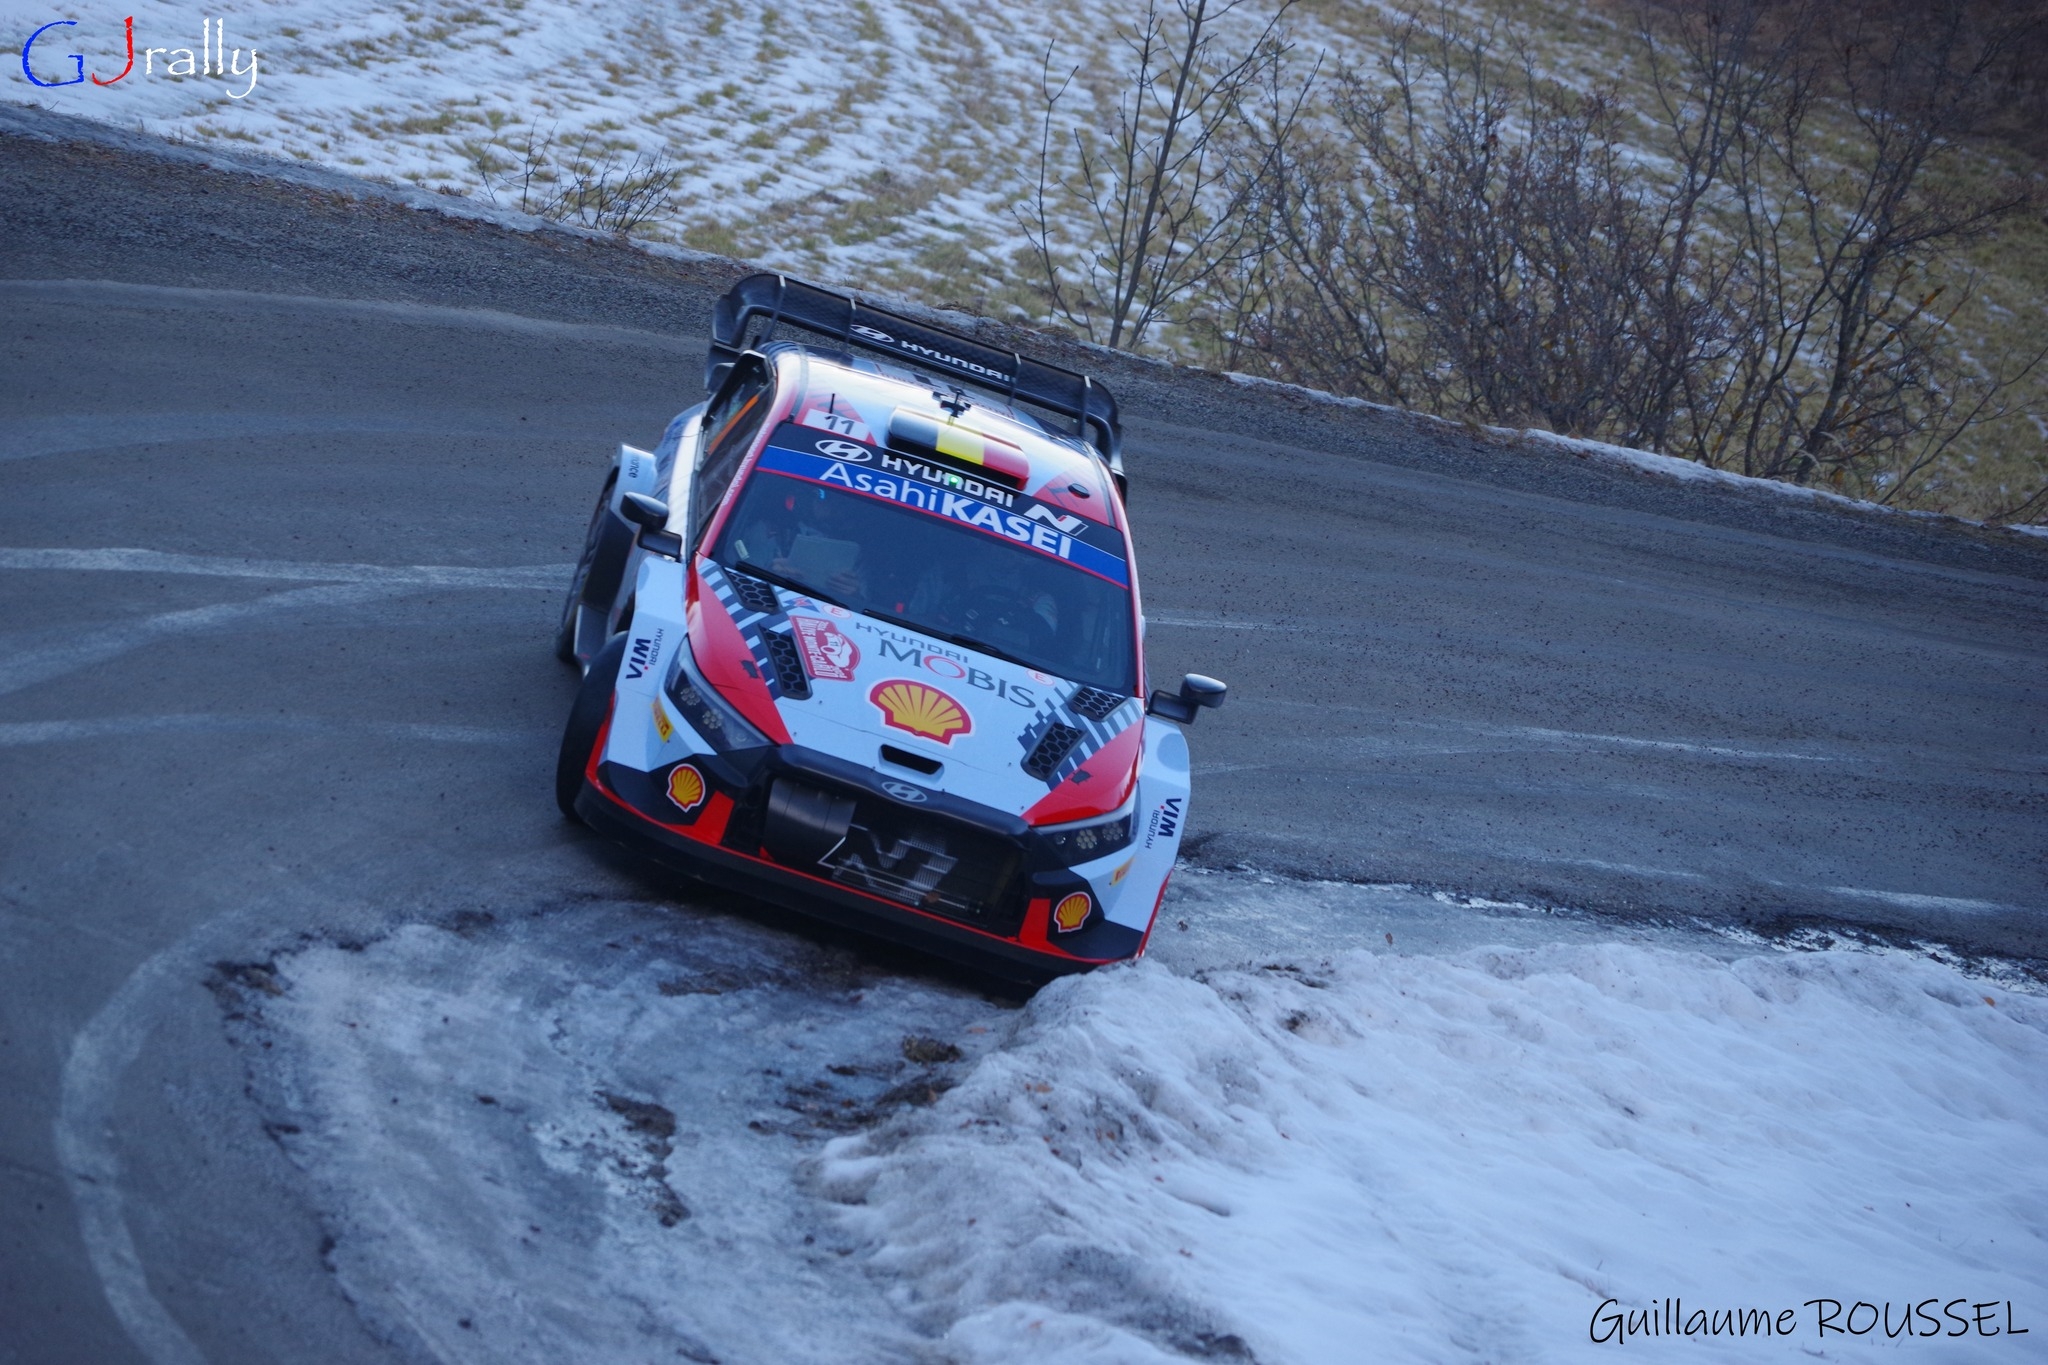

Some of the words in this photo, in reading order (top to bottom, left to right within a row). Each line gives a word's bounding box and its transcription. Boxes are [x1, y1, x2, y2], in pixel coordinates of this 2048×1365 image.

[901, 340, 1010, 382] HYUNDAI
[824, 415, 856, 435] 11
[881, 455, 1014, 507] HYUNDAI
[650, 628, 664, 666] HYUNDAI
[856, 622, 969, 663] HYUNDAI
[878, 639, 1036, 708] MOBIS
[1145, 809, 1160, 849] HYUNDAI
